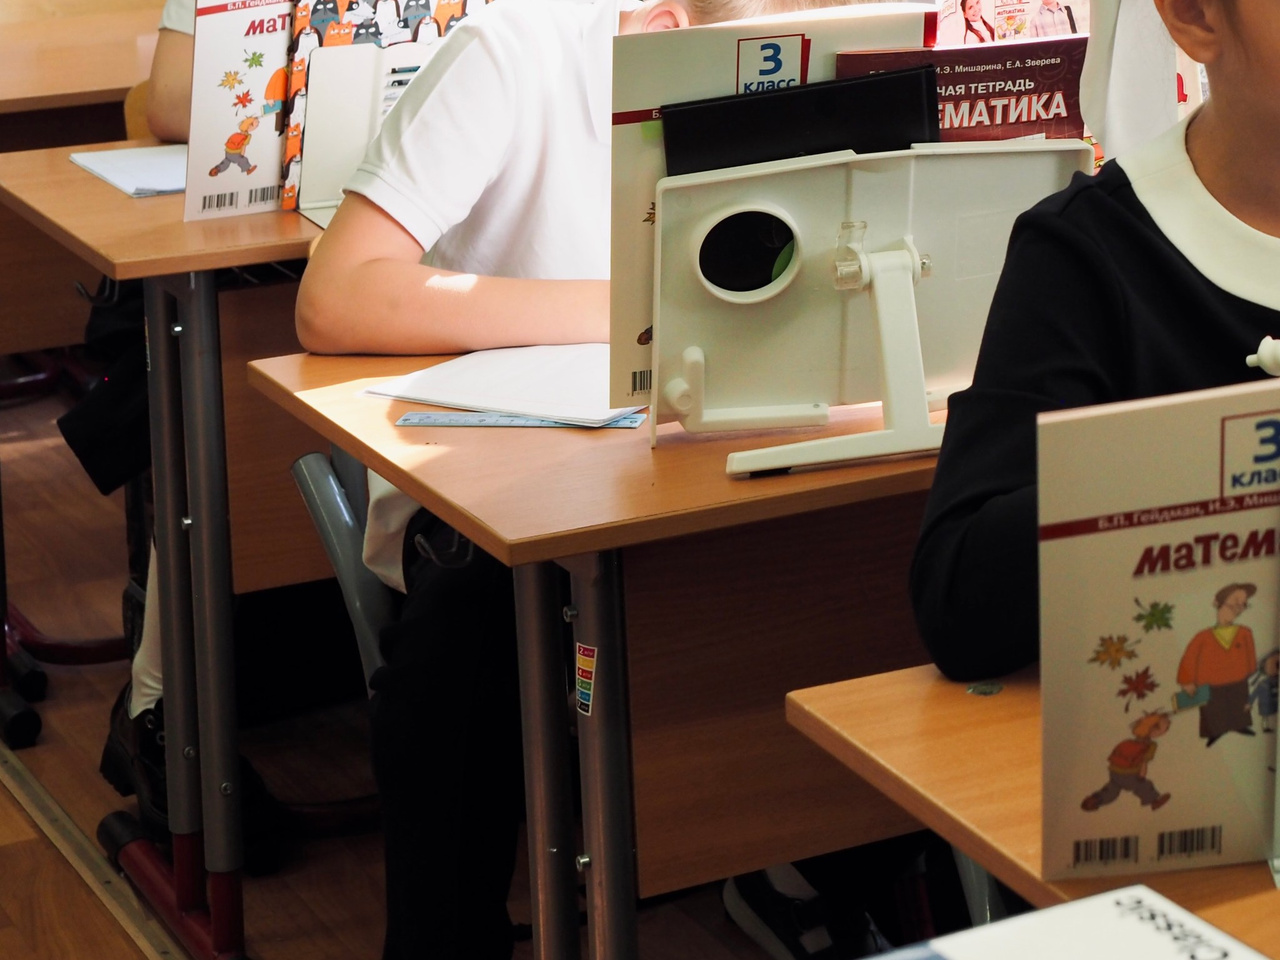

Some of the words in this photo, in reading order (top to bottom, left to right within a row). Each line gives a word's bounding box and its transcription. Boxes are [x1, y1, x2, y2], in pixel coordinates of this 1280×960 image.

[244, 12, 293, 37] мат
[759, 43, 783, 76] 3
[955, 62, 1004, 74] Мишарина,
[1006, 60, 1024, 69] Е.А.
[1025, 56, 1061, 68] Зверева
[744, 78, 796, 95] класс
[968, 78, 1035, 95] ТЕТРАДЬ
[1098, 514, 1129, 530] Б.П.
[1132, 505, 1205, 524] Гейдман,
[1208, 499, 1239, 514] И.Э.
